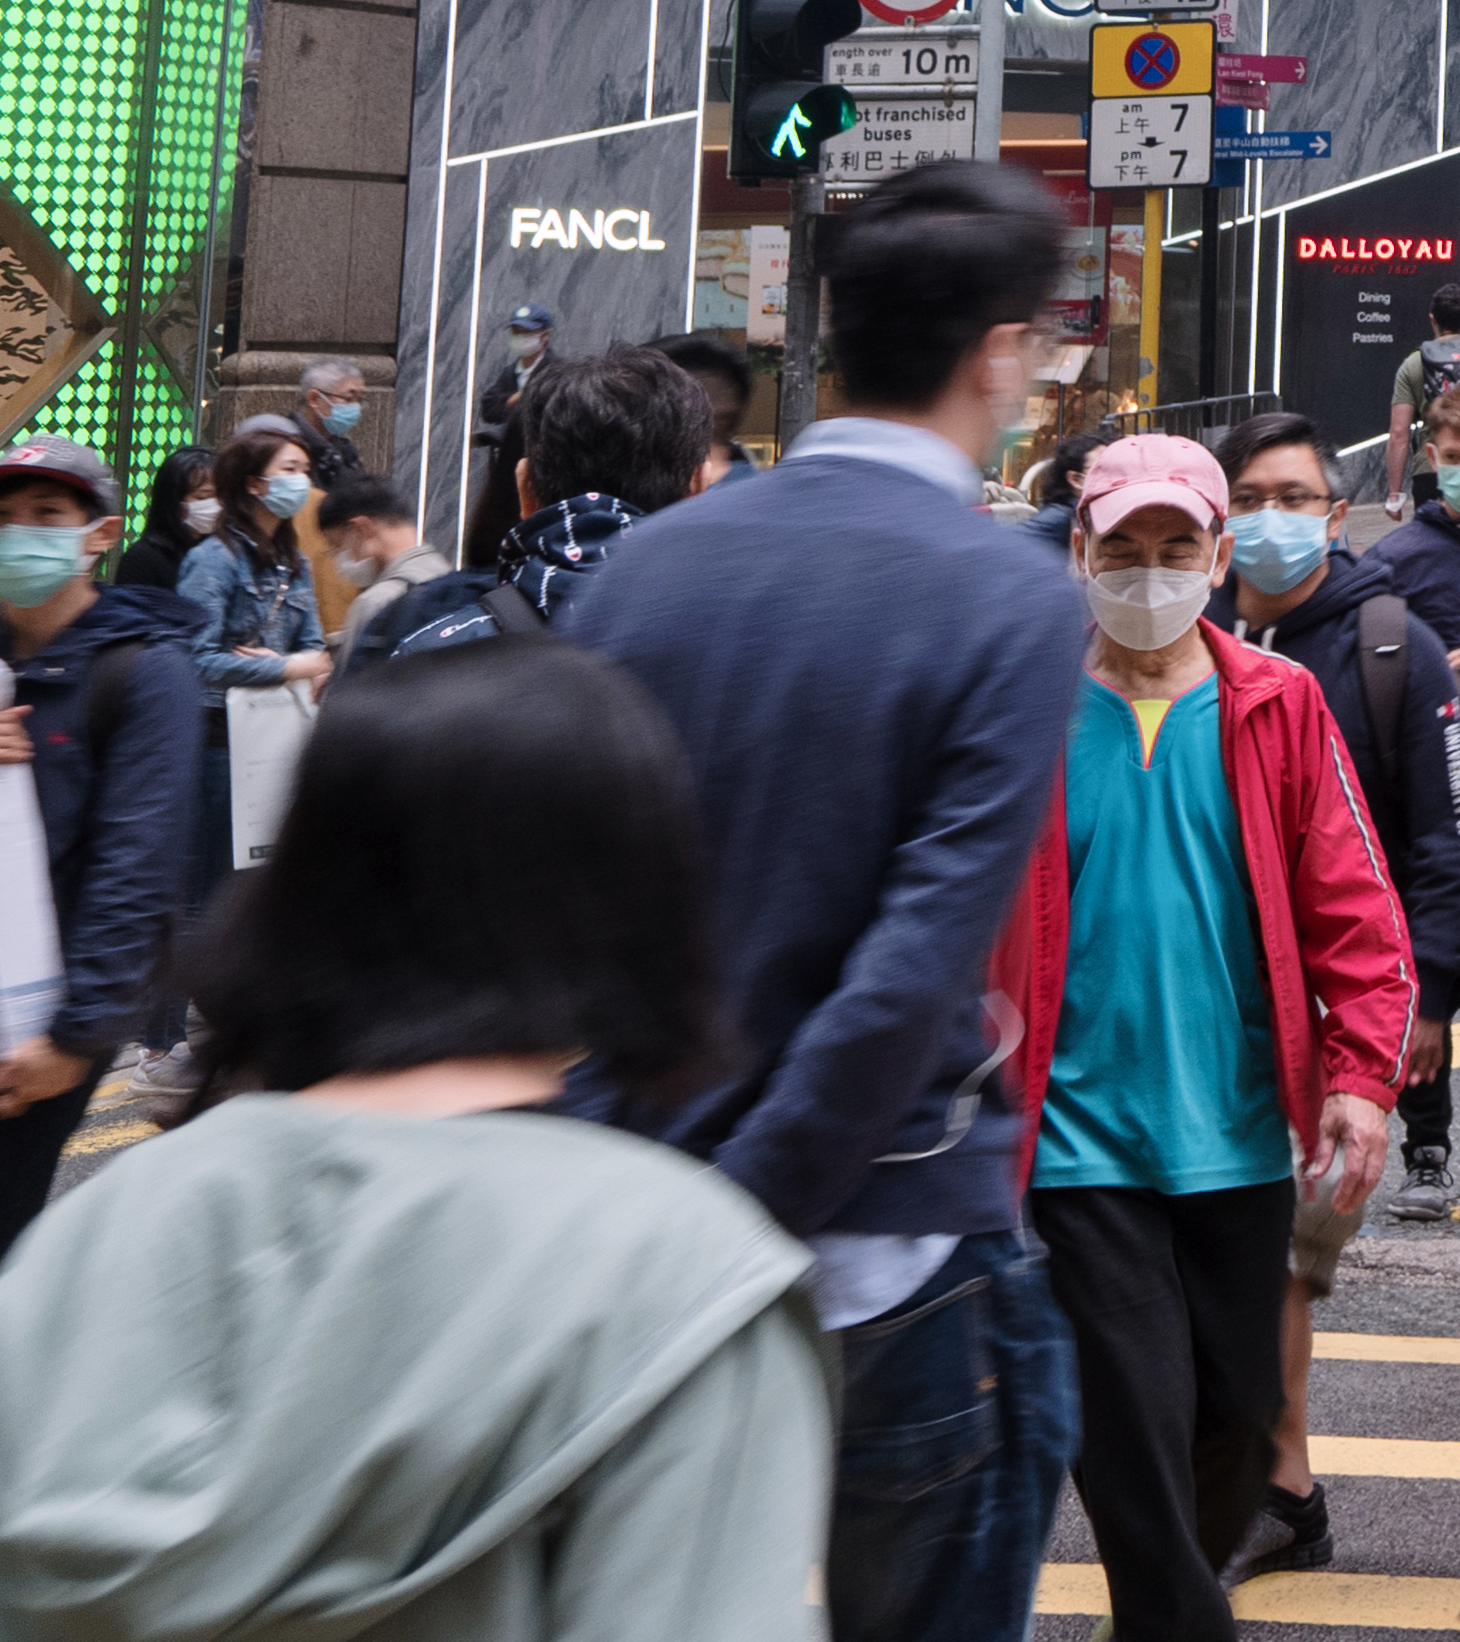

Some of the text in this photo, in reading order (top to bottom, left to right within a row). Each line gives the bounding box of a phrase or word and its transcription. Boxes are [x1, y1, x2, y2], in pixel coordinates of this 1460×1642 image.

[832, 47, 971, 77] ength over 10 m
[875, 105, 967, 123] franchised
[1121, 103, 1144, 114] am
[1114, 116, 1152, 135] 上午
[1169, 103, 1190, 134] 7
[862, 125, 913, 143] buses
[826, 148, 959, 173] 利巴士例外
[1120, 149, 1143, 164] pm
[1168, 149, 1190, 180] 7
[1114, 164, 1150, 182] 下午
[510, 207, 667, 251] FANCL
[1298, 237, 1454, 260] DALLOYAU
[1358, 291, 1392, 306] Dining
[1356, 311, 1391, 324] Coffee
[1352, 332, 1394, 345] Pastries
